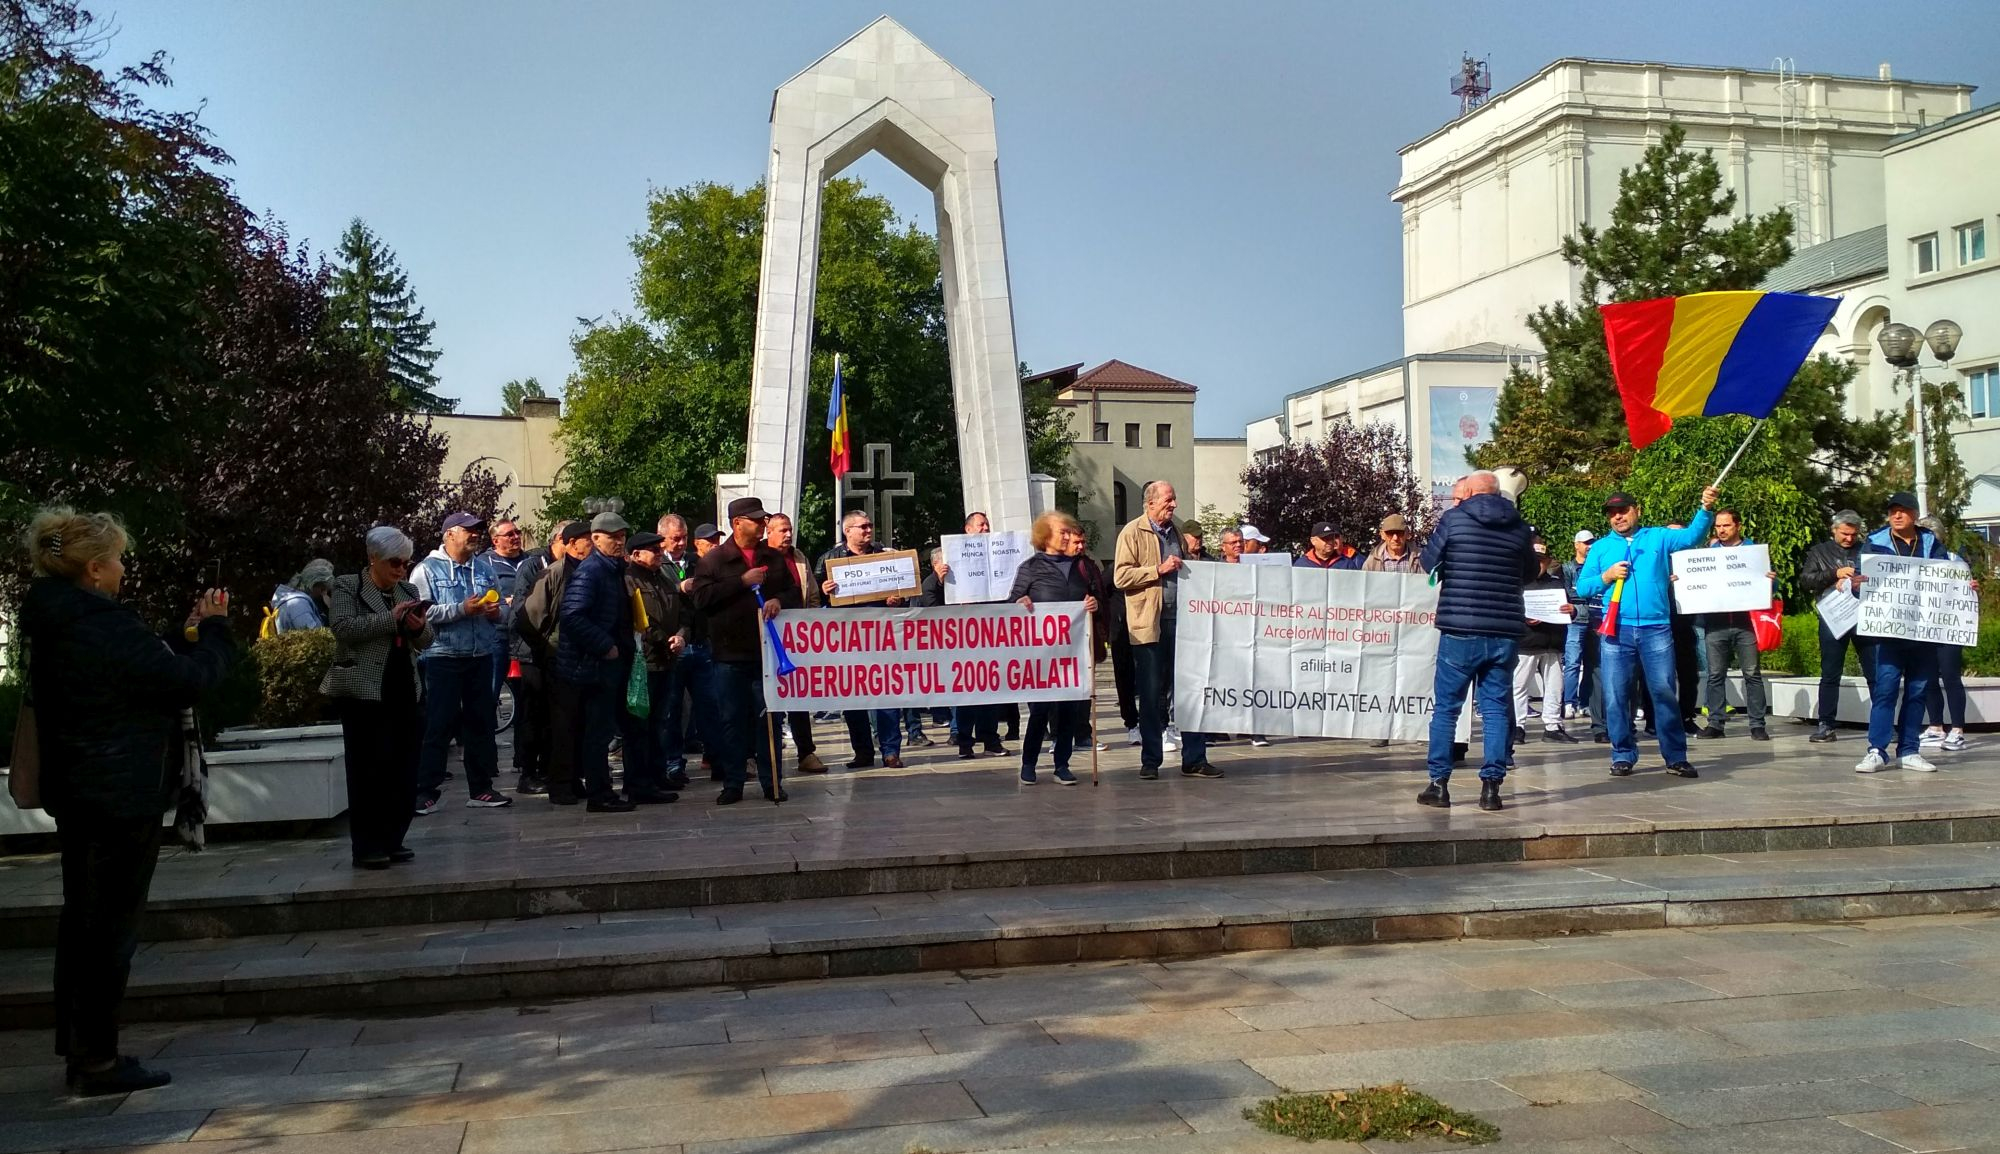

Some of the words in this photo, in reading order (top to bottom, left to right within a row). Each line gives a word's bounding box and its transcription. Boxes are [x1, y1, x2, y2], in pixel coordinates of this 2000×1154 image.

[844, 570, 863, 579] PSD
[880, 565, 898, 574] PNL
[1867, 576, 1880, 588] UN
[1884, 577, 1910, 589] DREPT
[1914, 580, 1949, 593] OBTINUT
[1188, 600, 1265, 617] SINDICATUL
[1270, 603, 1304, 619] LIBER
[1307, 606, 1324, 620] AL
[1326, 607, 1436, 625] SIDERURGISTILOR
[1865, 590, 1893, 604] TEMEI
[1898, 593, 1925, 607] LEGAL
[1928, 596, 1941, 608] NU
[1952, 598, 1978, 613] POATE
[782, 620, 897, 653] ASOCIATIA
[903, 614, 1071, 651] PENSIONARILOR
[1264, 624, 1348, 642] ArcelorMittal
[1352, 629, 1391, 645] Galati
[777, 663, 945, 698] SIDERURGISTUL
[951, 660, 1000, 693] 2006
[1006, 657, 1079, 690] GALATI
[1300, 658, 1336, 673] afiliat
[1340, 660, 1352, 674] la
[1203, 687, 1237, 708] FNS
[1242, 689, 1383, 713] SOLIDARITATEA
